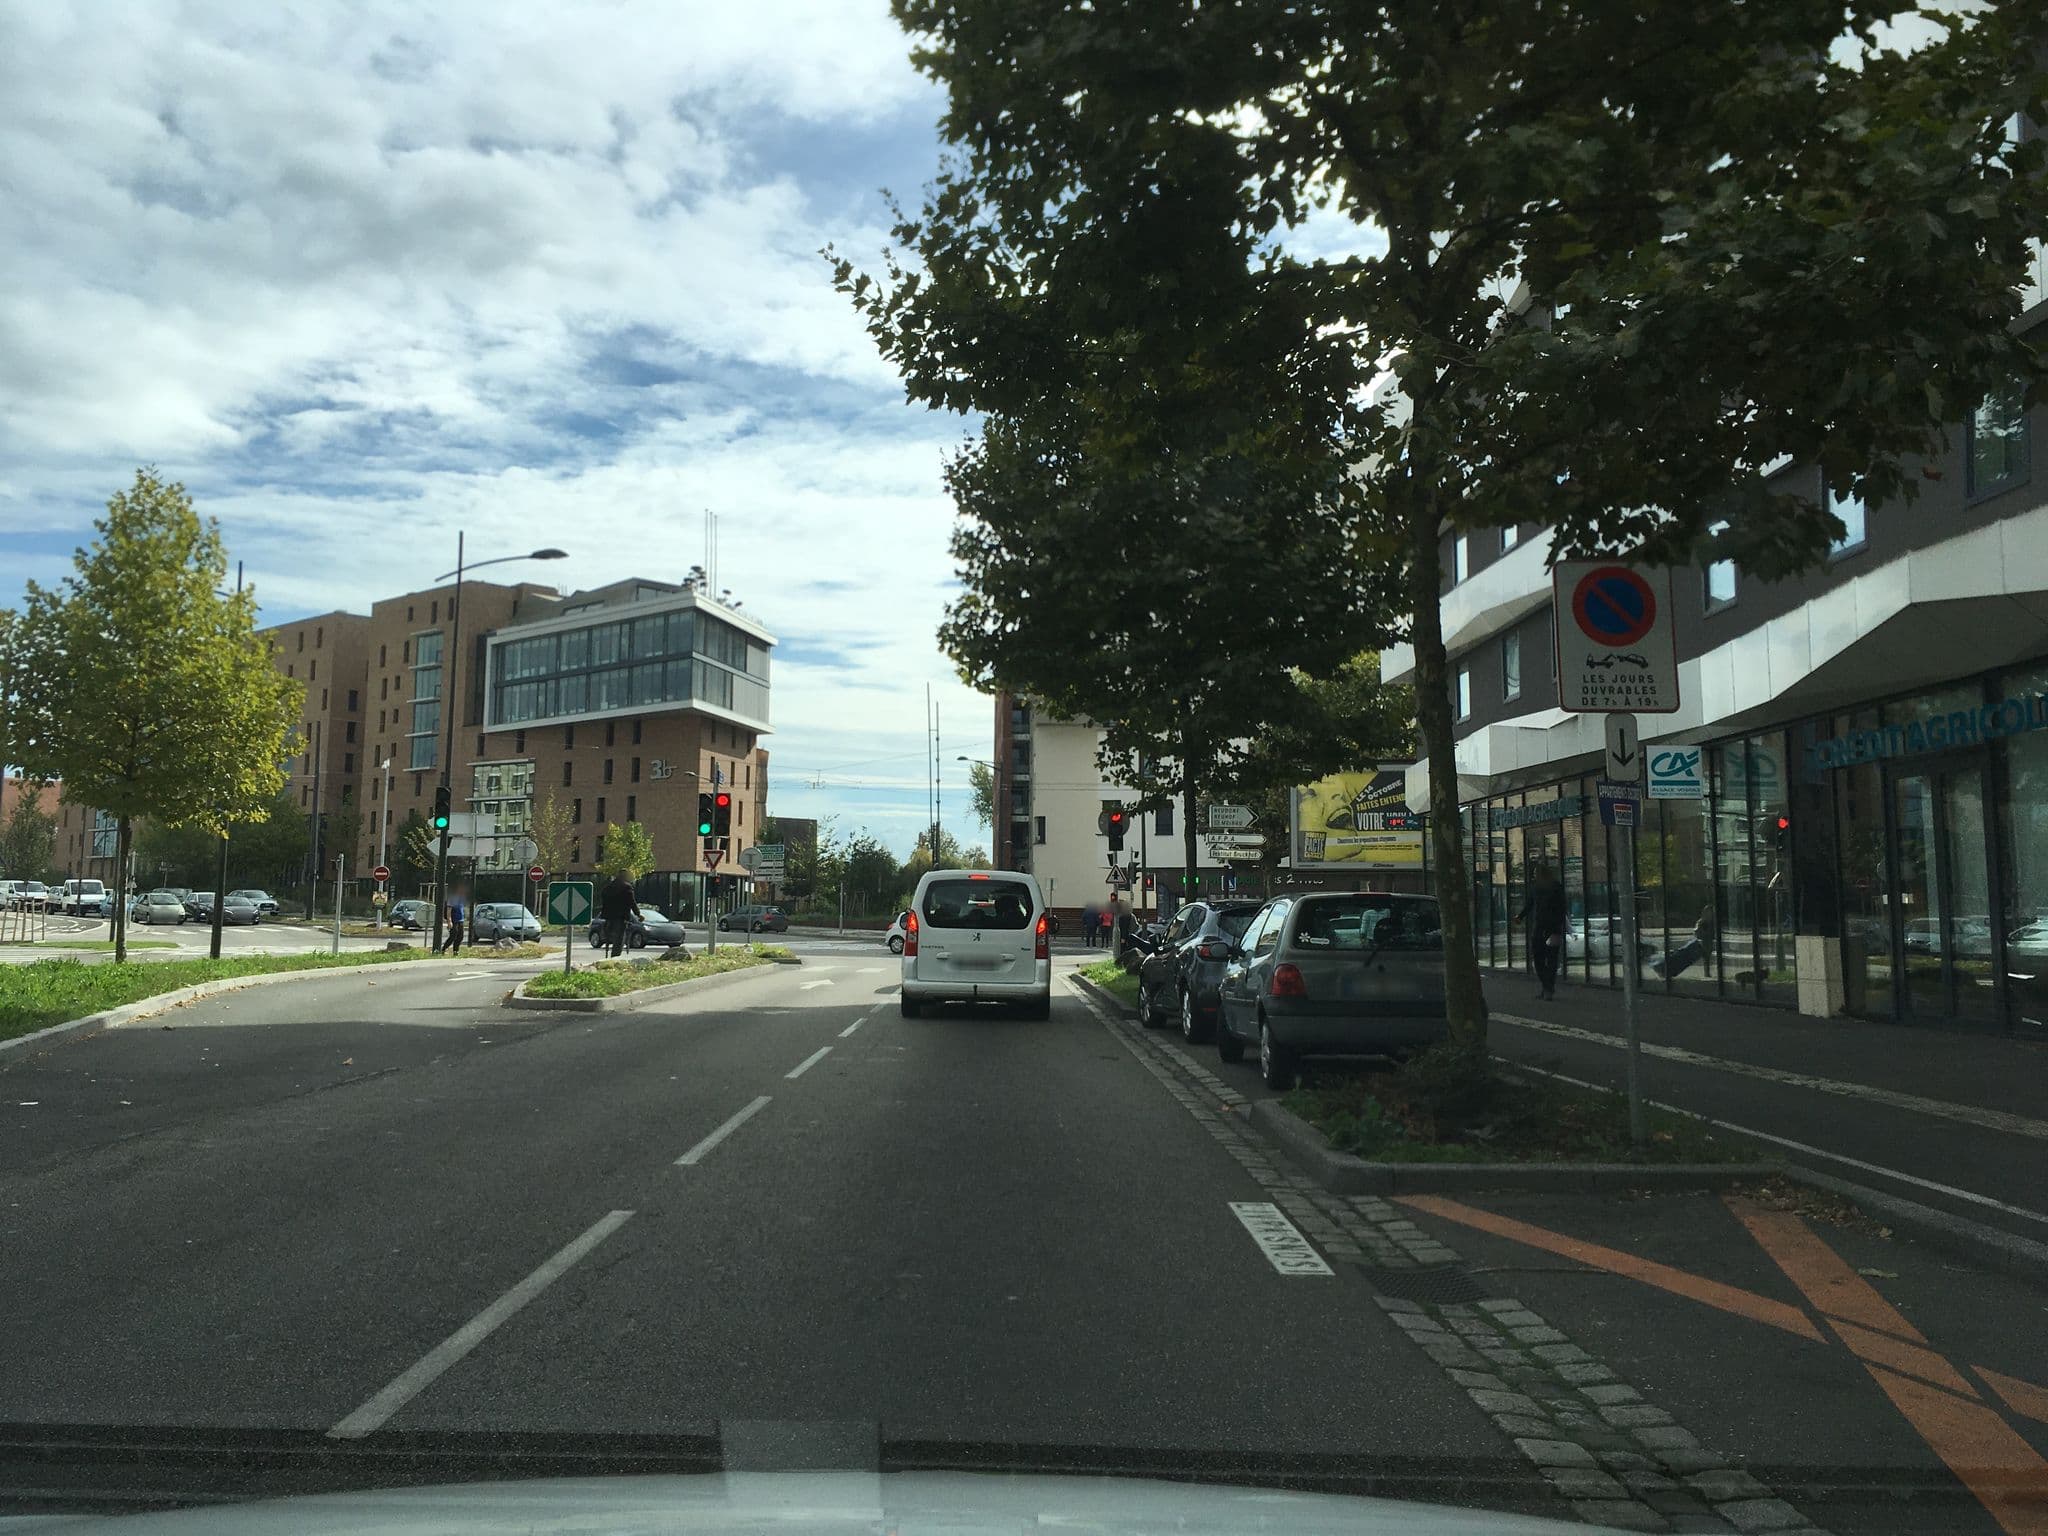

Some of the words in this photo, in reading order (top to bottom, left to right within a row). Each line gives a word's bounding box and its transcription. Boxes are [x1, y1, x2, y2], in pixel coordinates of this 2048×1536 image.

[1582, 674, 1606, 684] LES
[1611, 674, 1655, 684] JOURS
[1582, 685, 1657, 695] OUVRABLES
[1582, 697, 1597, 706] DE
[1367, 779, 1403, 800] OCTOBRE
[1356, 799, 1379, 812] FAITES
[1357, 812, 1385, 830] VOTRE
